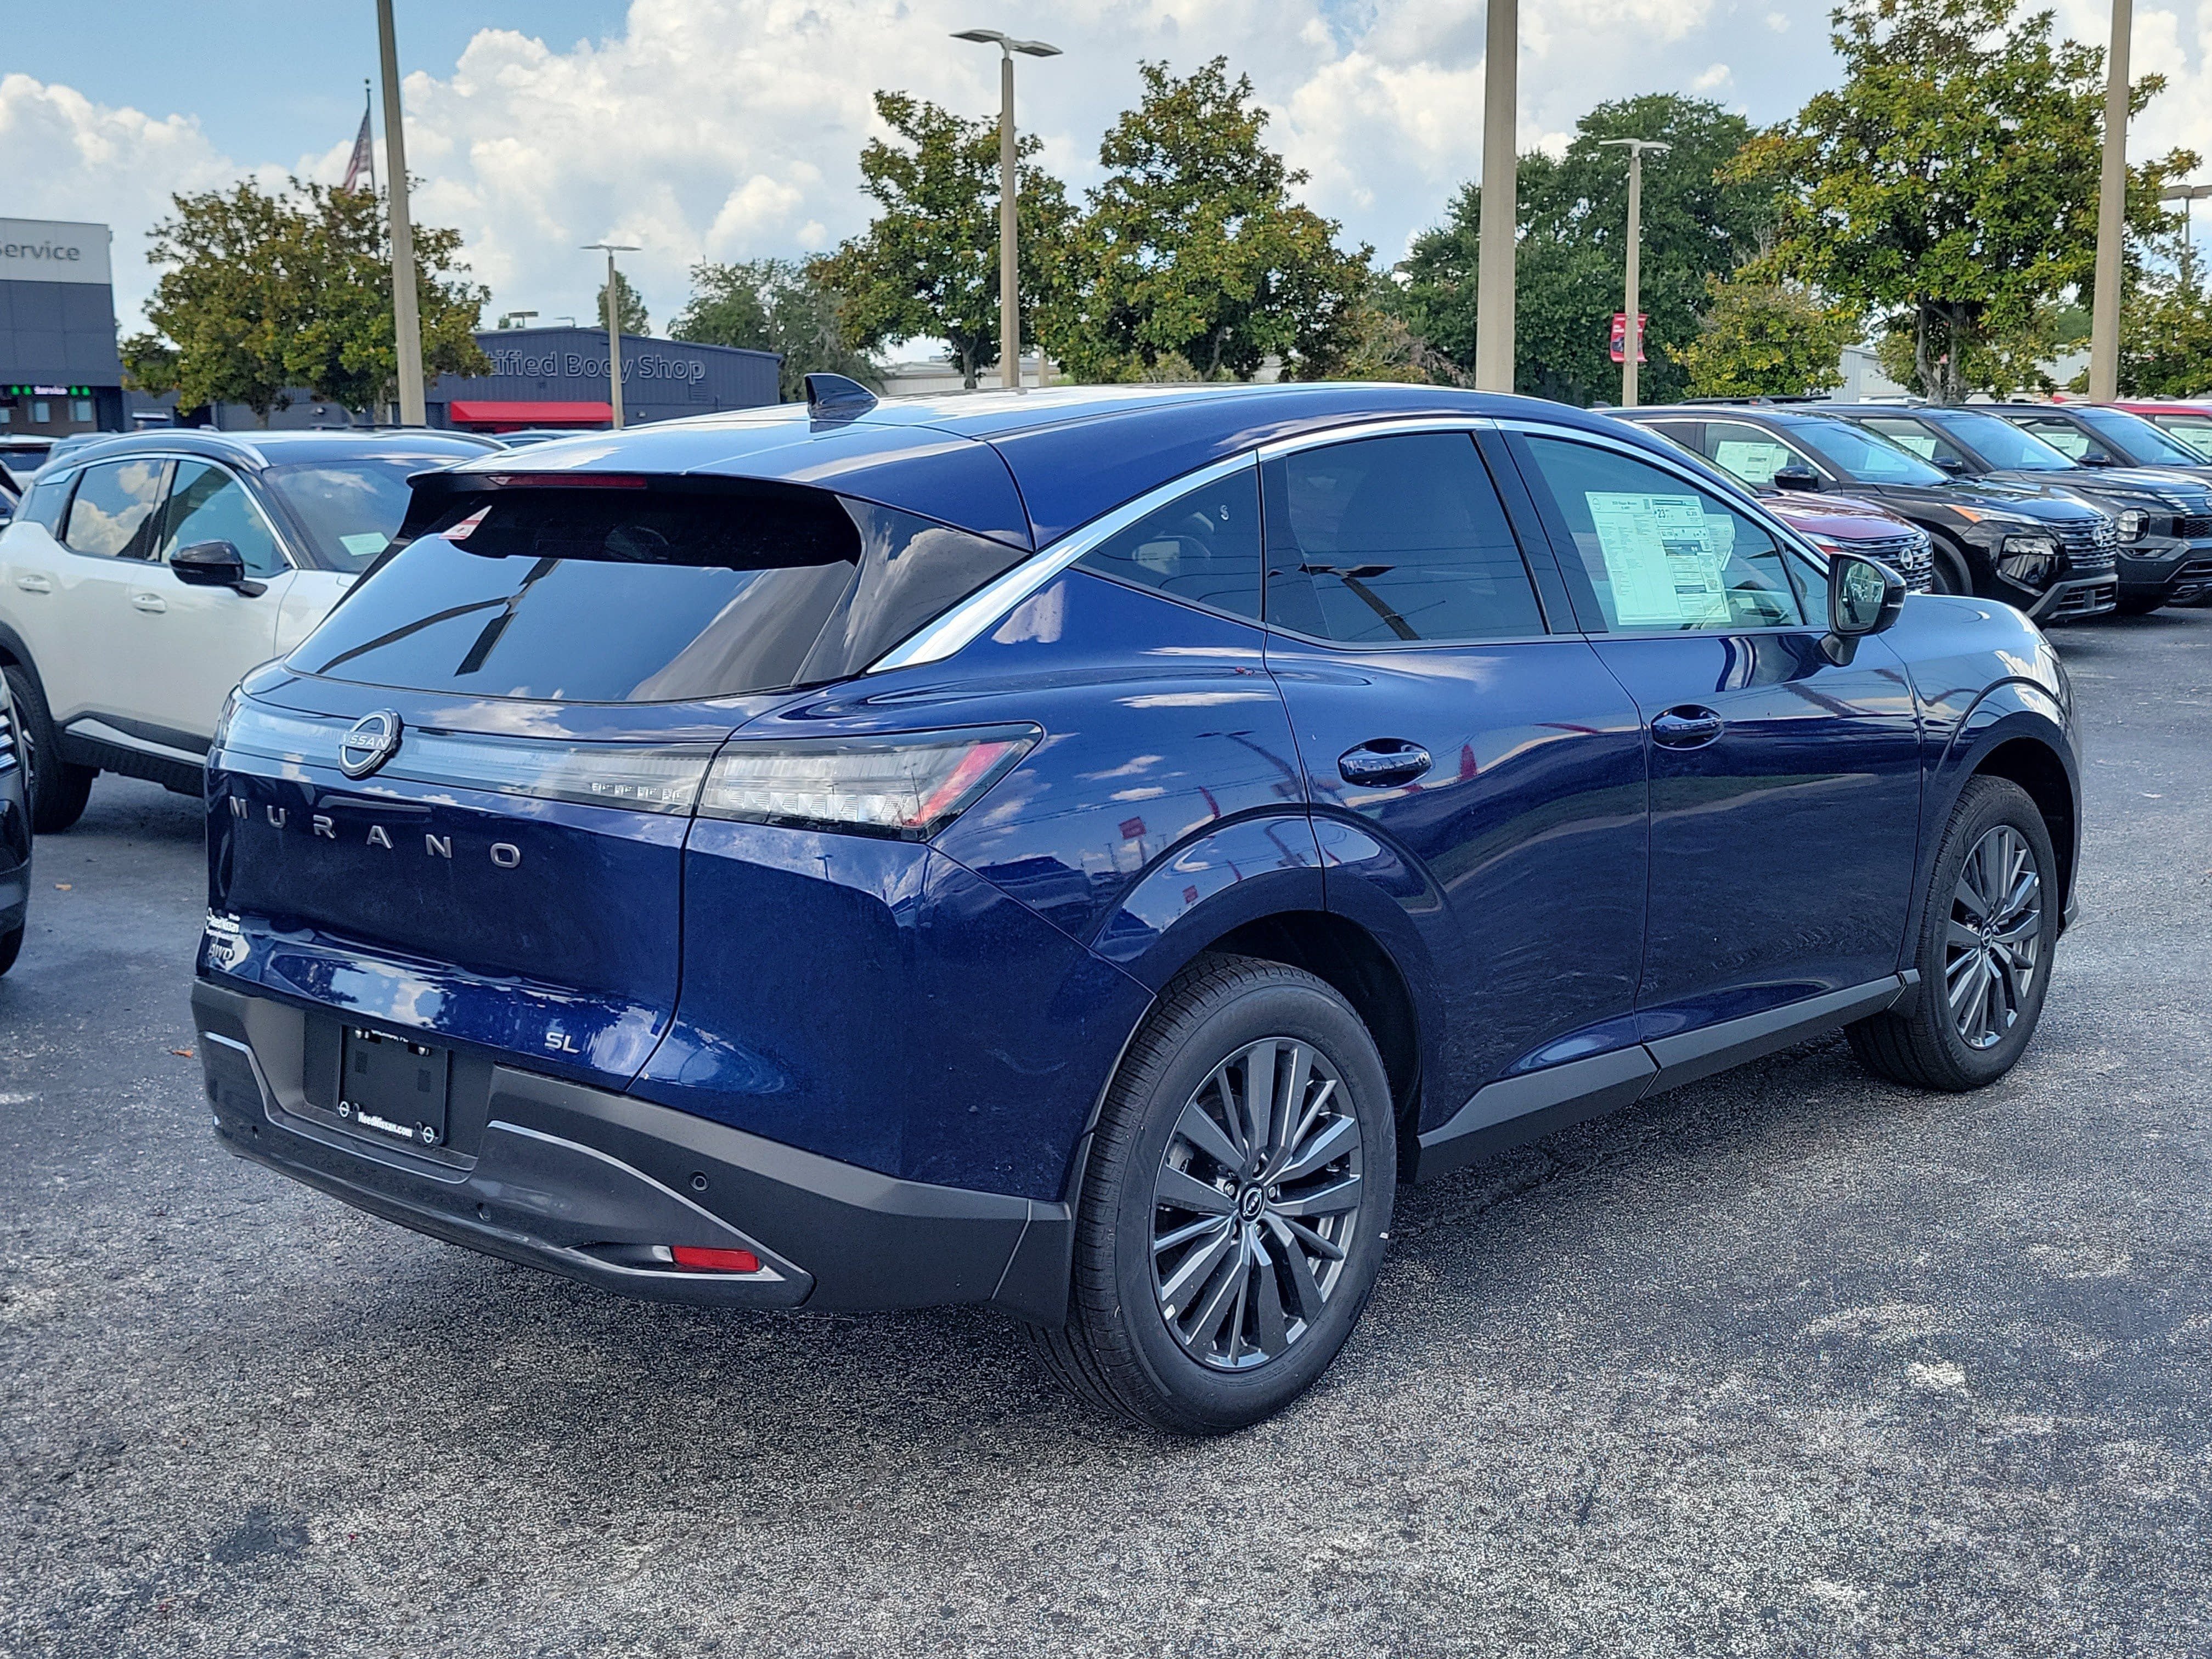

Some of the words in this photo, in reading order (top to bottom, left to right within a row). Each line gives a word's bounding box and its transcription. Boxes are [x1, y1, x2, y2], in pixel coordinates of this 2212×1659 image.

[0, 239, 81, 262] ervice
[486, 349, 557, 376] tified
[638, 354, 706, 384] Shop
[229, 795, 521, 868] MURANO
[208, 943, 235, 961] AWD
[544, 1031, 580, 1054] SL
[358, 1111, 413, 1138] ReedNissan.com
